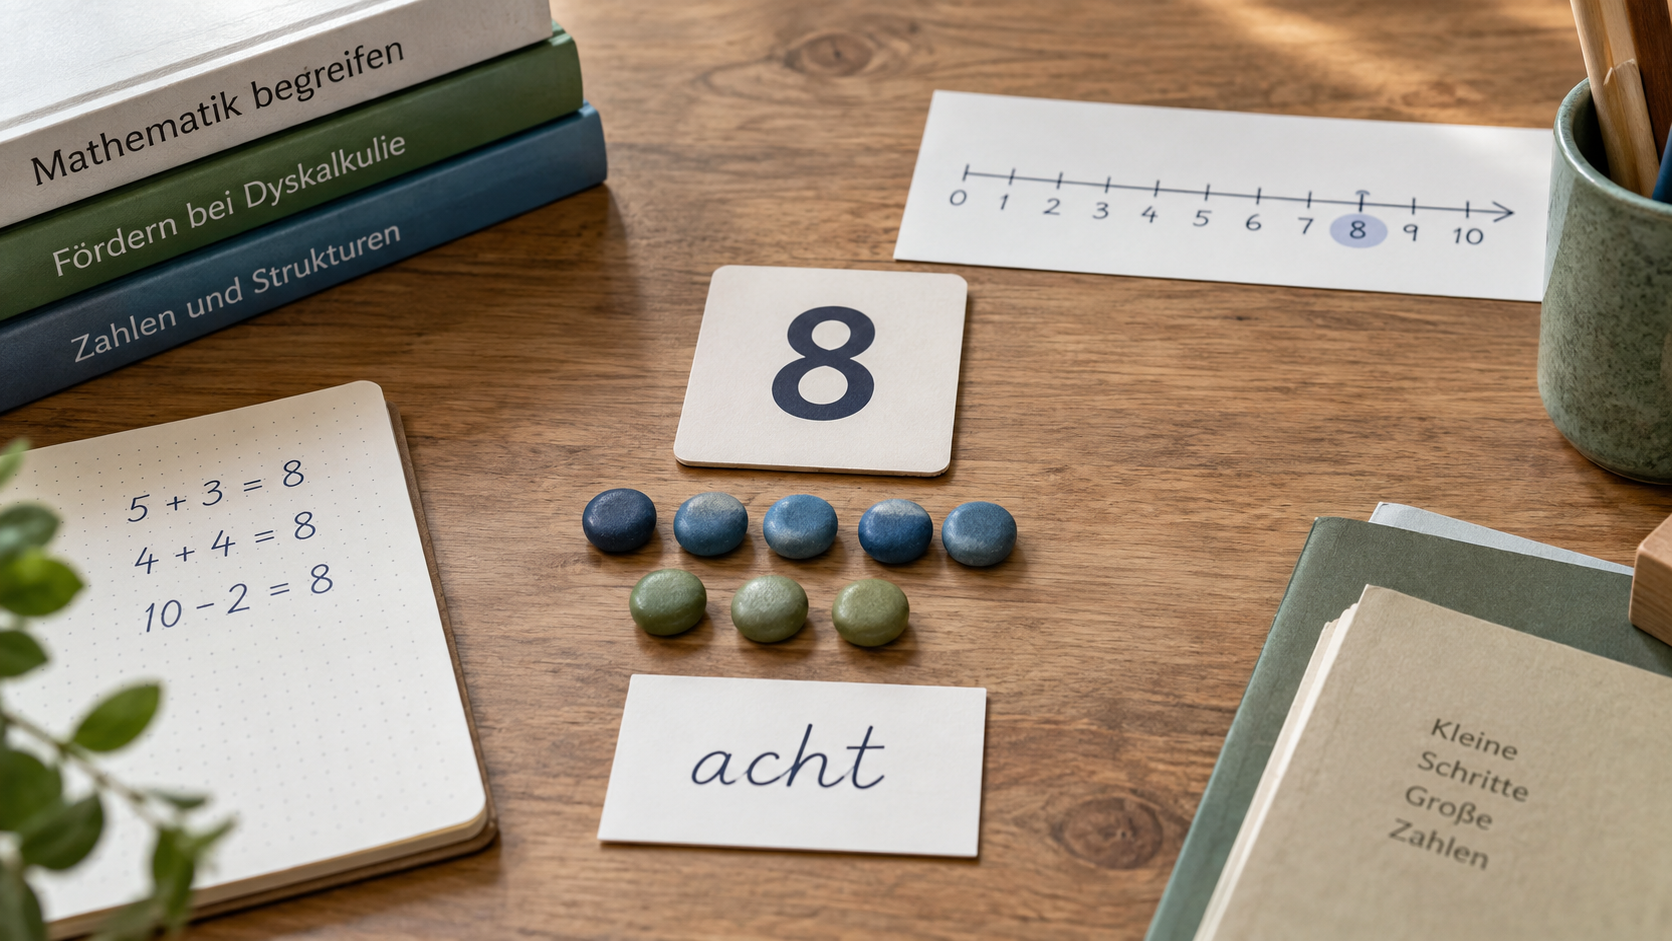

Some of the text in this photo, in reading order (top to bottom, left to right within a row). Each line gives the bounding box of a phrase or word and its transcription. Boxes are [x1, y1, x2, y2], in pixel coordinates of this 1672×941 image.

[30, 42, 404, 186] Mathematik begreifen
[52, 135, 406, 277] Fördern bei Dyskalkulie
[949, 189, 1484, 245] 0 1 2 3 4 5 6 7 8 9 10
[70, 225, 401, 363] Zahlen und Strukturen
[771, 305, 876, 422] 8
[127, 459, 305, 523] 5 + 3 = 8
[134, 511, 316, 575] 4 + 4 = 8
[145, 599, 182, 633] 10
[227, 583, 250, 615] 2
[269, 582, 290, 597] =
[310, 563, 333, 594] 8
[691, 723, 885, 790] acht
[1430, 718, 1518, 761] Kleine
[1405, 785, 1493, 830] Große
[1417, 750, 1530, 803] Schritte
[1389, 817, 1490, 870] Zahlen
